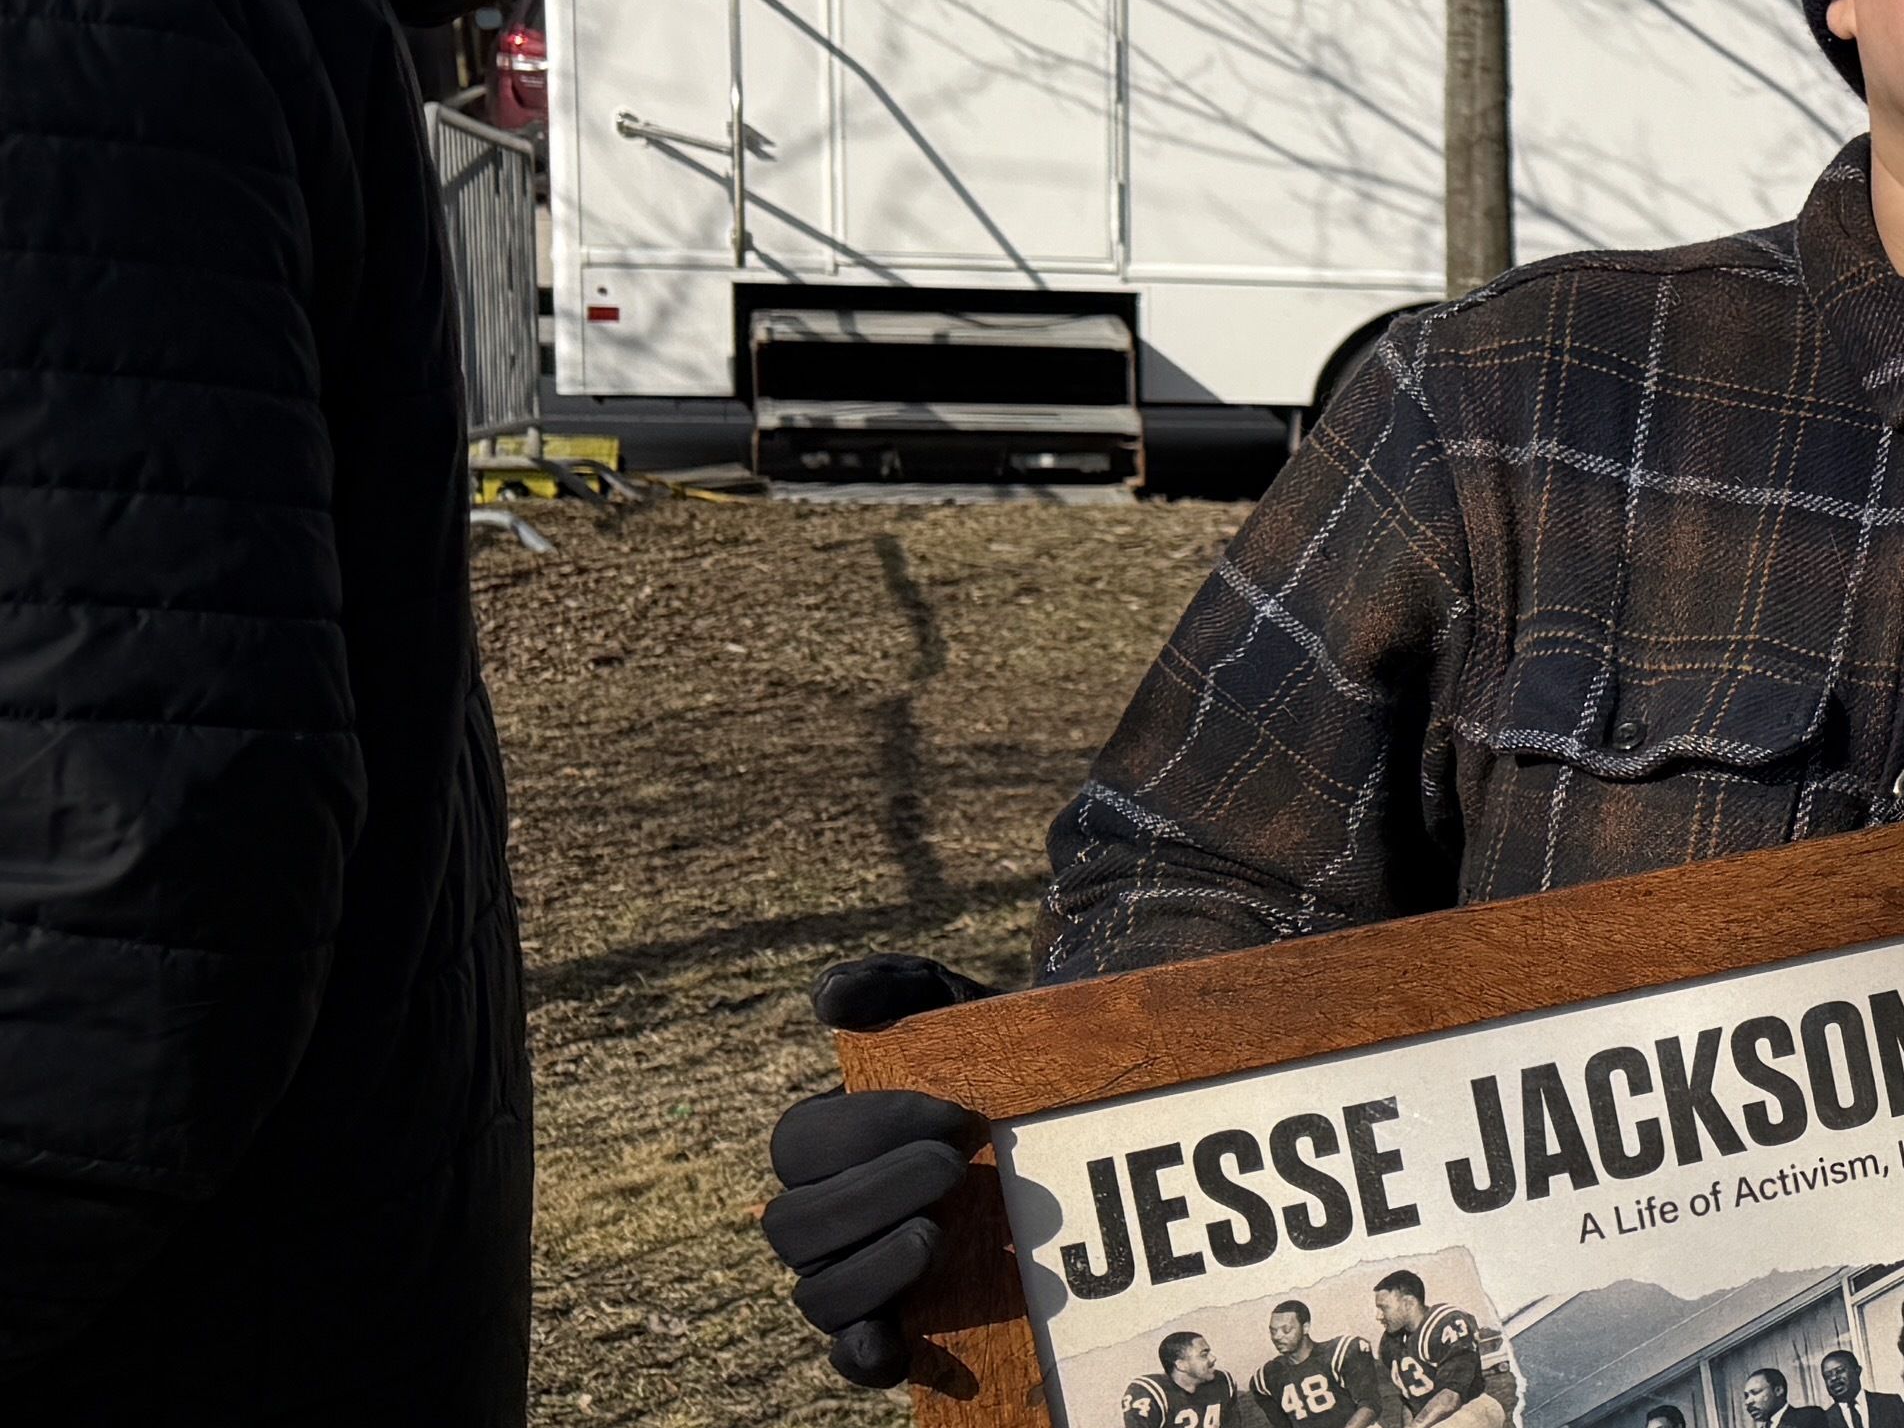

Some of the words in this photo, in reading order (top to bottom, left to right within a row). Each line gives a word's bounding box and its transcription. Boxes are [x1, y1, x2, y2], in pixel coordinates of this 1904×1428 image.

[1060, 1096, 1420, 1299] JESSE
[1579, 1212, 1605, 1244] A
[1613, 1195, 1679, 1234] Life
[1689, 1180, 1721, 1216] of
[1734, 1154, 1888, 1207] Activism,
[1280, 1374, 1336, 1421] 48
